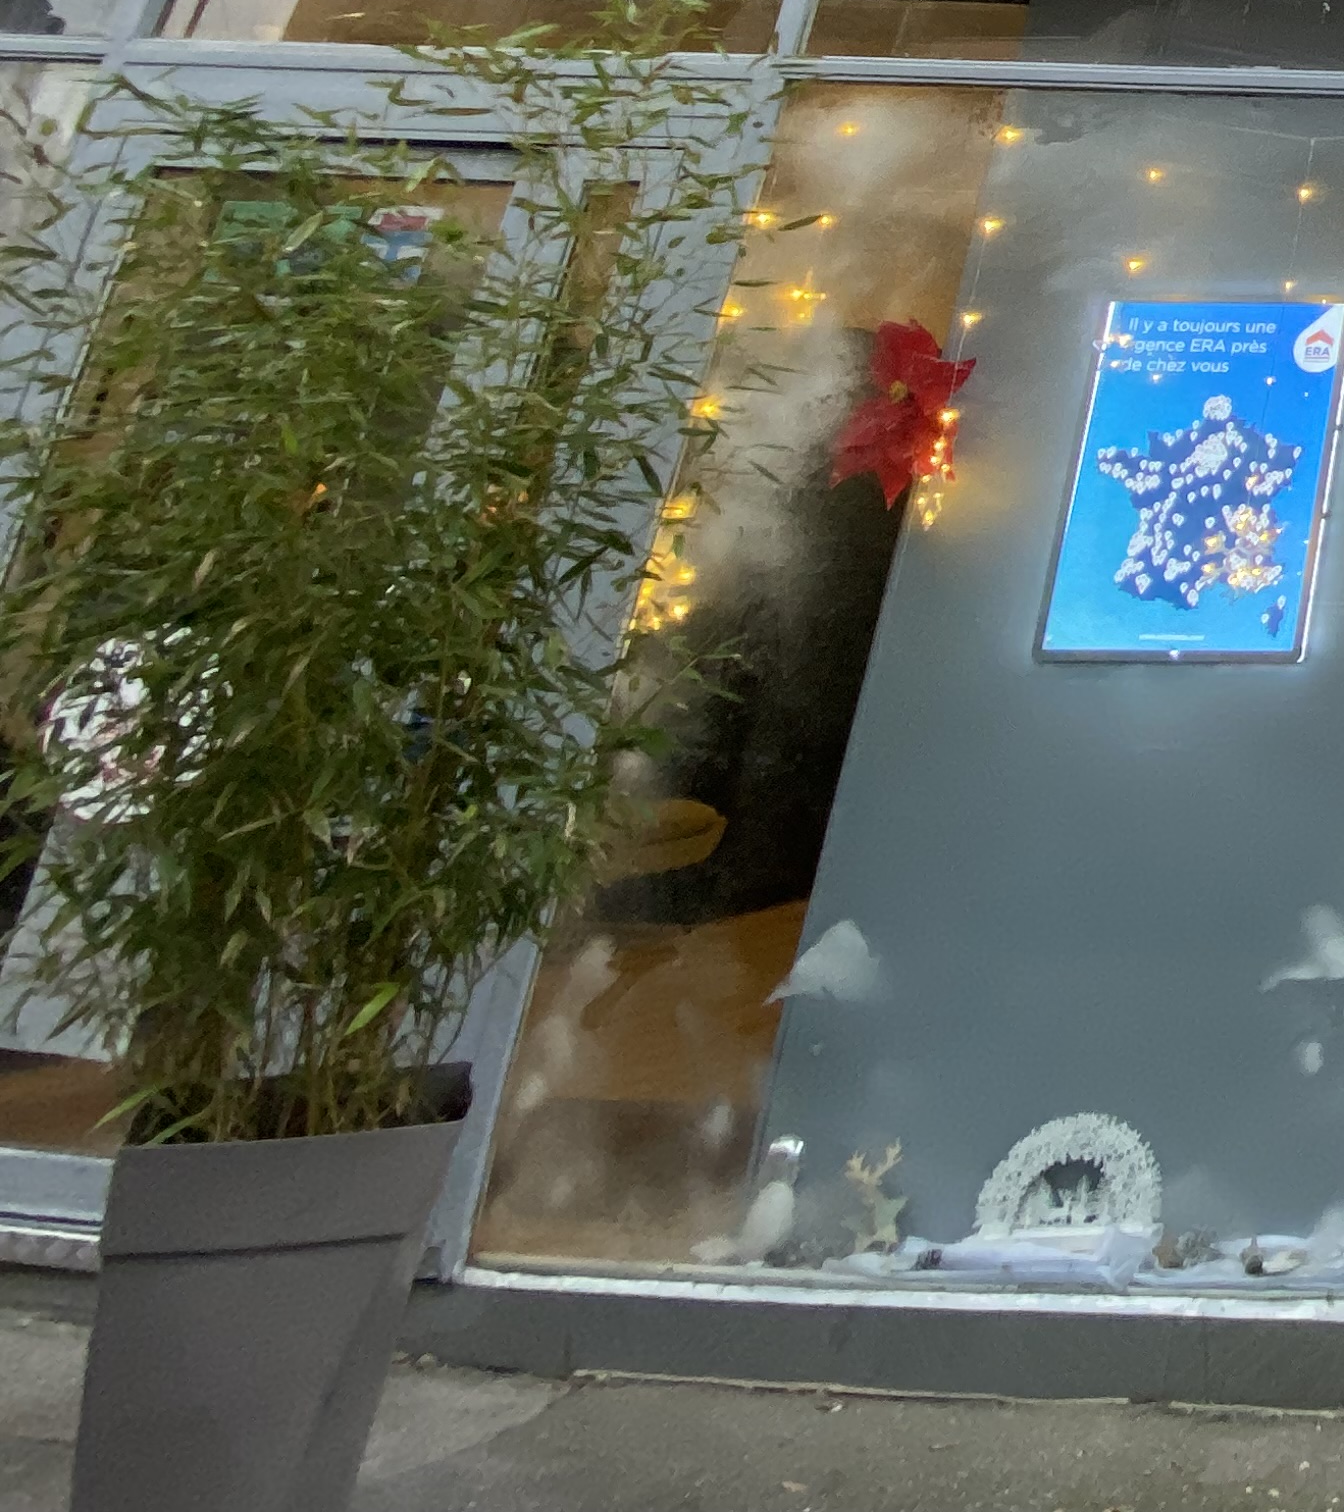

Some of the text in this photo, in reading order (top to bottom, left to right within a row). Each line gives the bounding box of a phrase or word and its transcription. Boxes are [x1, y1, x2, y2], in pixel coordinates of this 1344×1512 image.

[1128, 317, 1277, 335] Il y a toujours une
[1132, 338, 1267, 357] gence ERA près
[1304, 346, 1331, 357] ERA
[1190, 361, 1230, 373] vous
